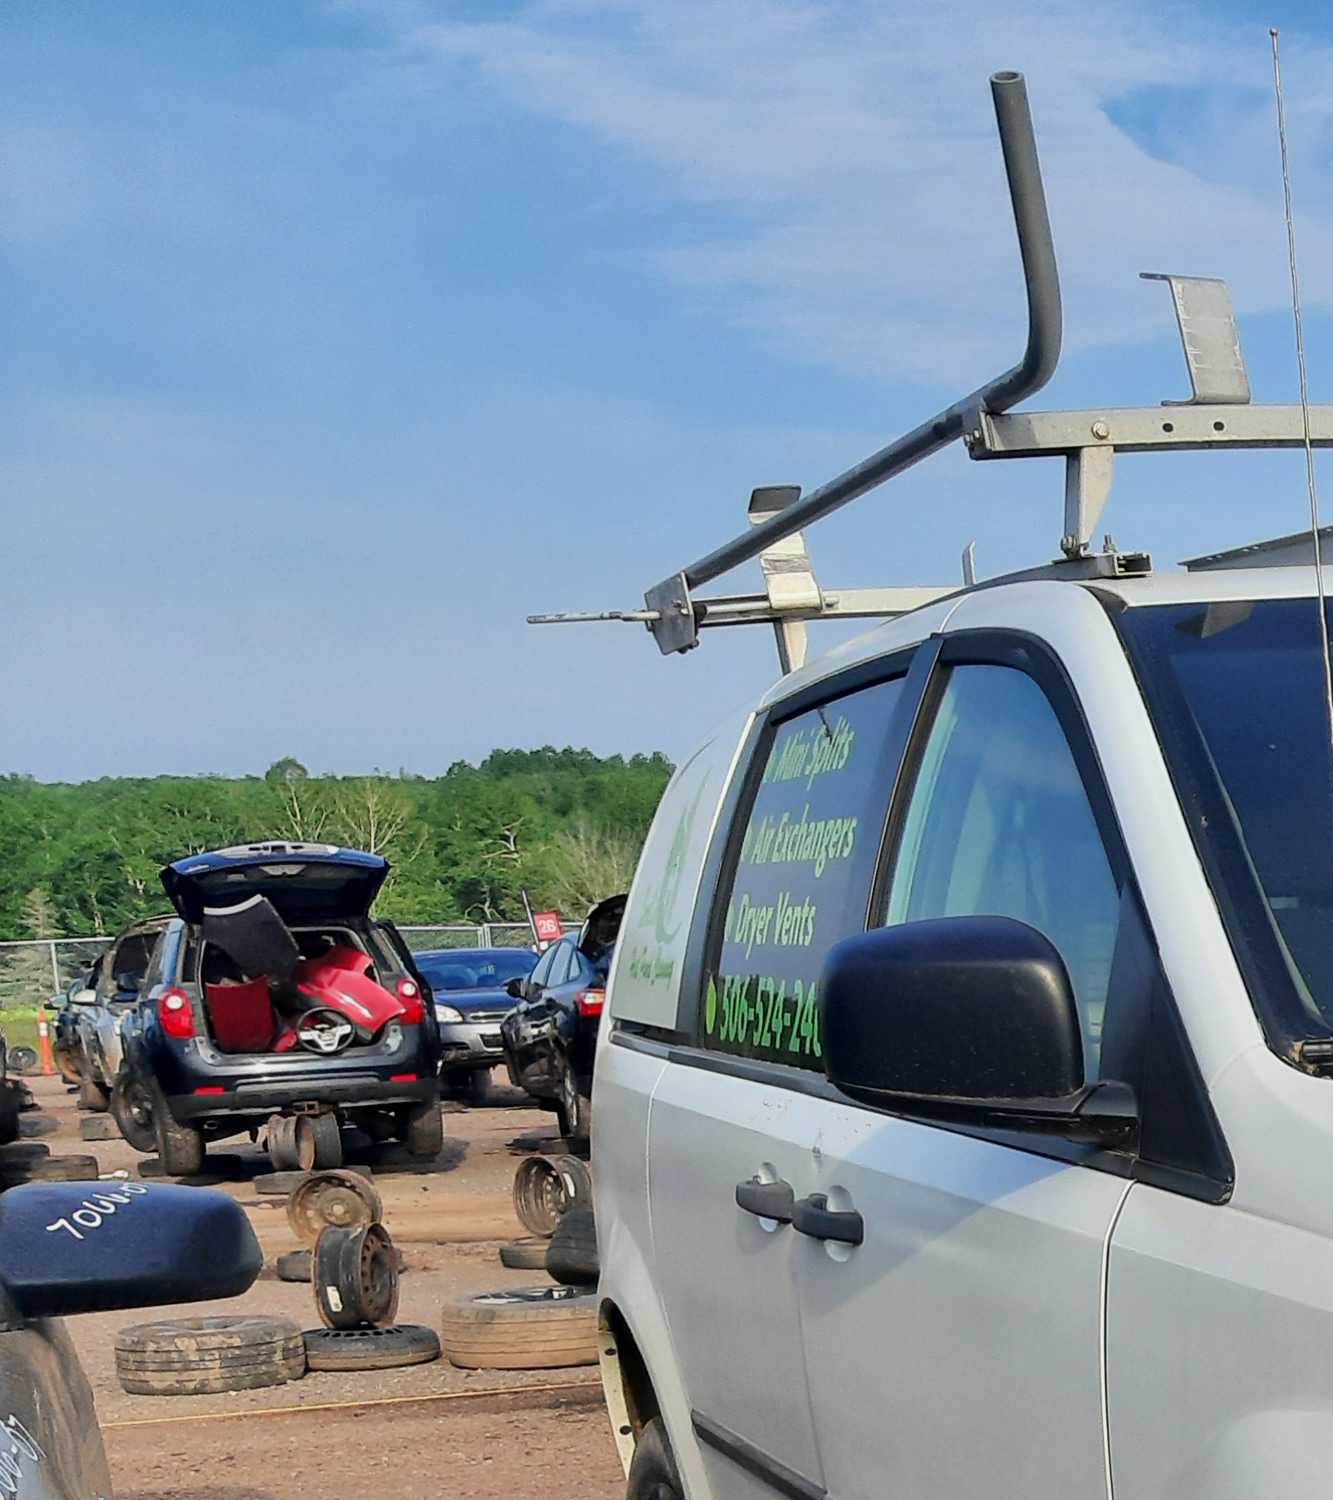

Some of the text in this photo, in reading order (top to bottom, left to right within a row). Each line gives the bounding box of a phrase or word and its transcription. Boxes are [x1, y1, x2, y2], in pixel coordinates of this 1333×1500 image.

[771, 802, 858, 878] Exchangers
[734, 891, 816, 961] Dryer Vents
